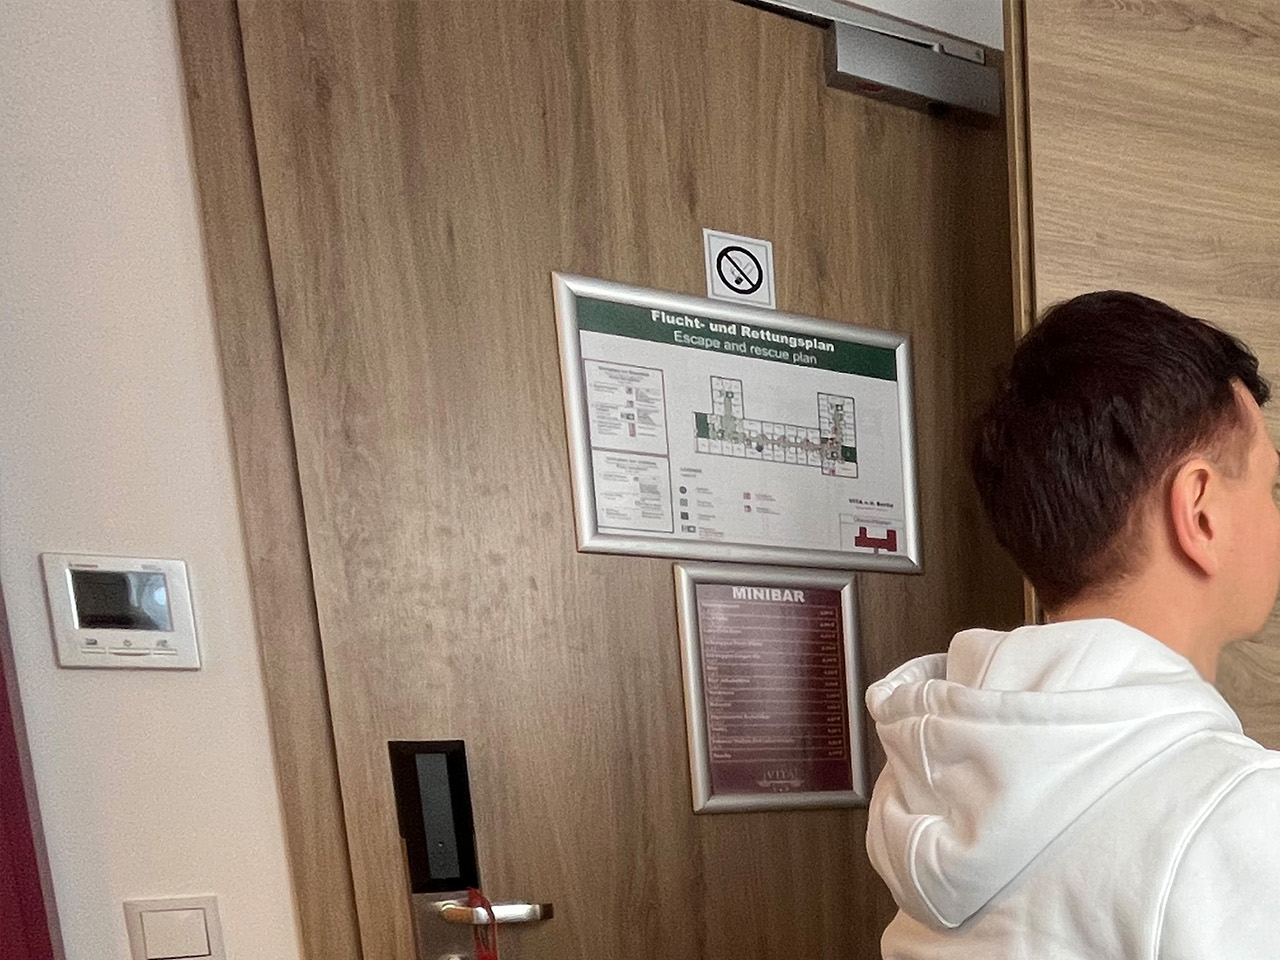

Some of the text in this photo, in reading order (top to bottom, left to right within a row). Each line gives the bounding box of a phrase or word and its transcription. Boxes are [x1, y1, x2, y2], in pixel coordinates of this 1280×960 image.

[651, 309, 835, 352] Flucht- und Rettungsplan
[673, 330, 818, 365] Escape and rescue plan
[732, 586, 806, 603] MINIBAR
